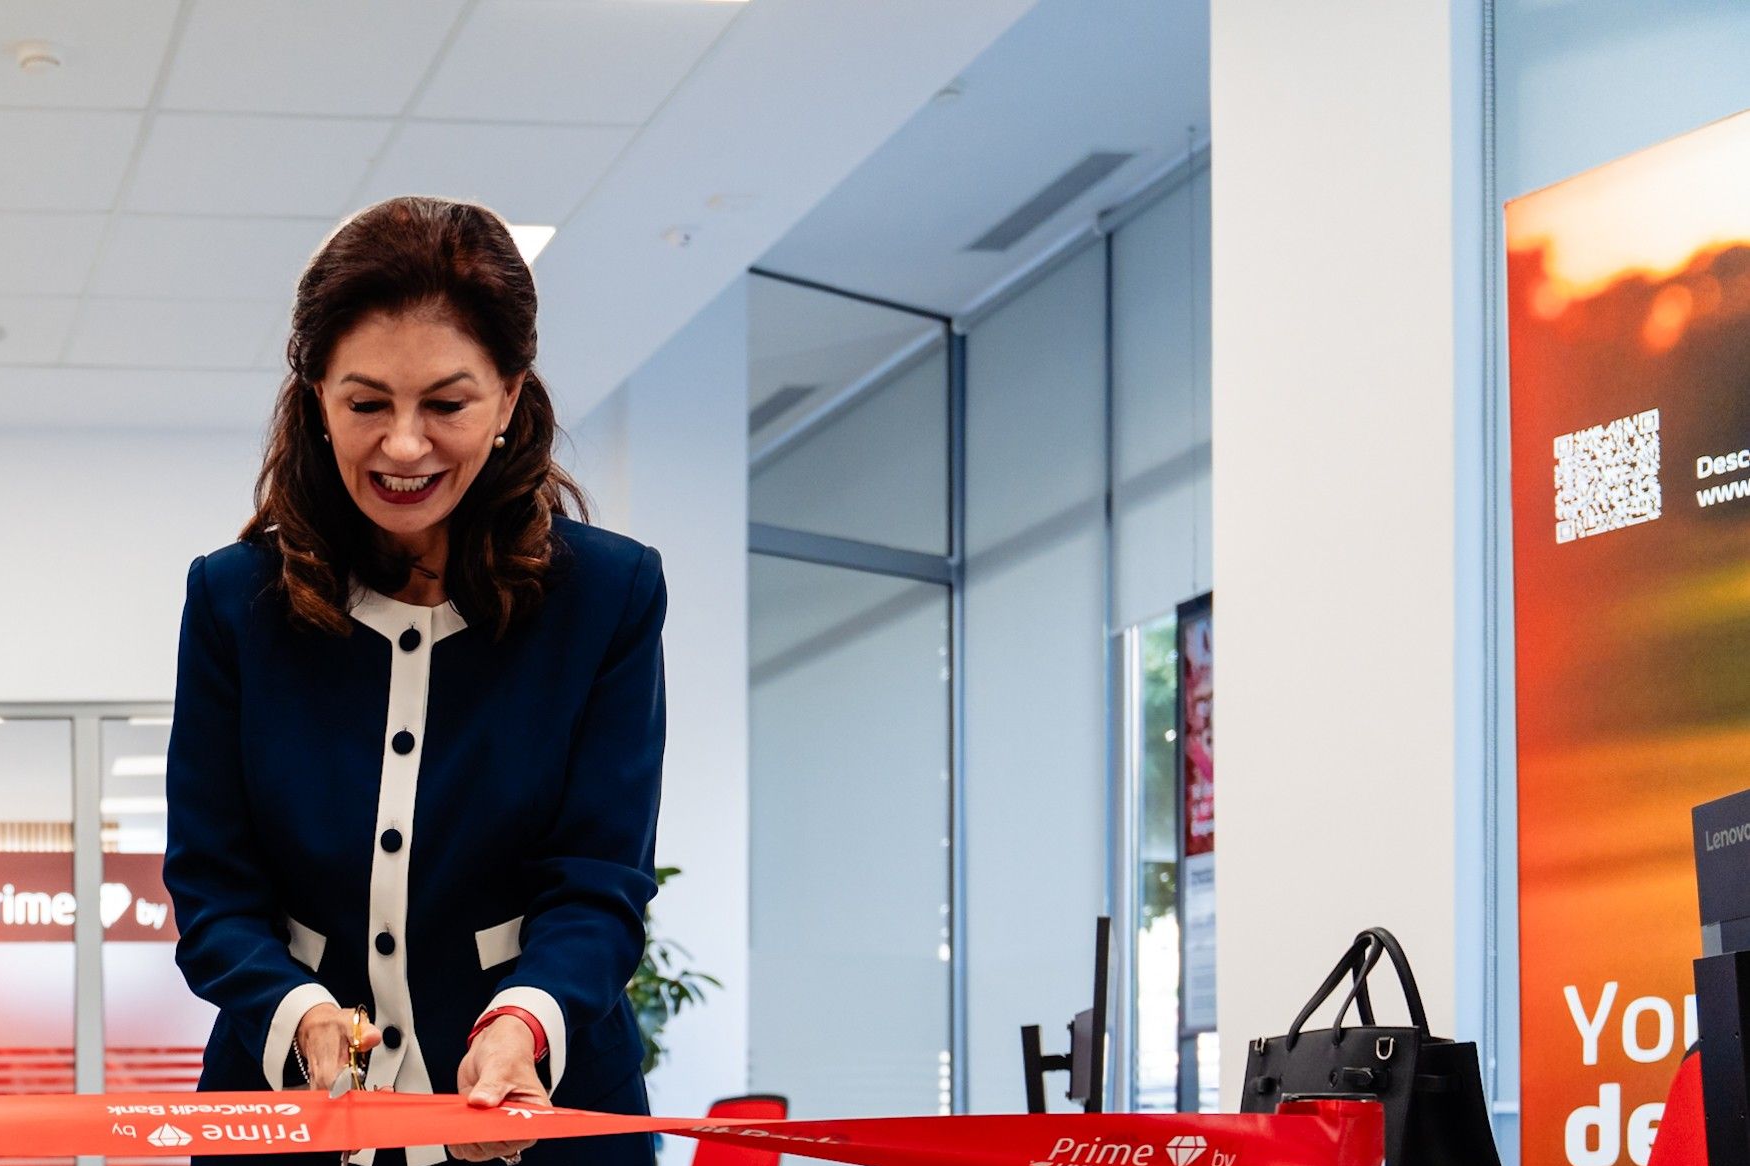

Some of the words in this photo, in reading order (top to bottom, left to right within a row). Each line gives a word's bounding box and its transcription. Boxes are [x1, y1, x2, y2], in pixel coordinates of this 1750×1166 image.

[1696, 449, 1750, 479] Desc
[1705, 823, 1750, 851] Lenovo
[136, 898, 167, 929] by
[107, 1104, 166, 1115] Bank
[170, 1104, 273, 1115] UniCredit
[112, 1122, 137, 1139] by
[202, 1123, 311, 1145] Prime
[1047, 1137, 1155, 1166] Prime
